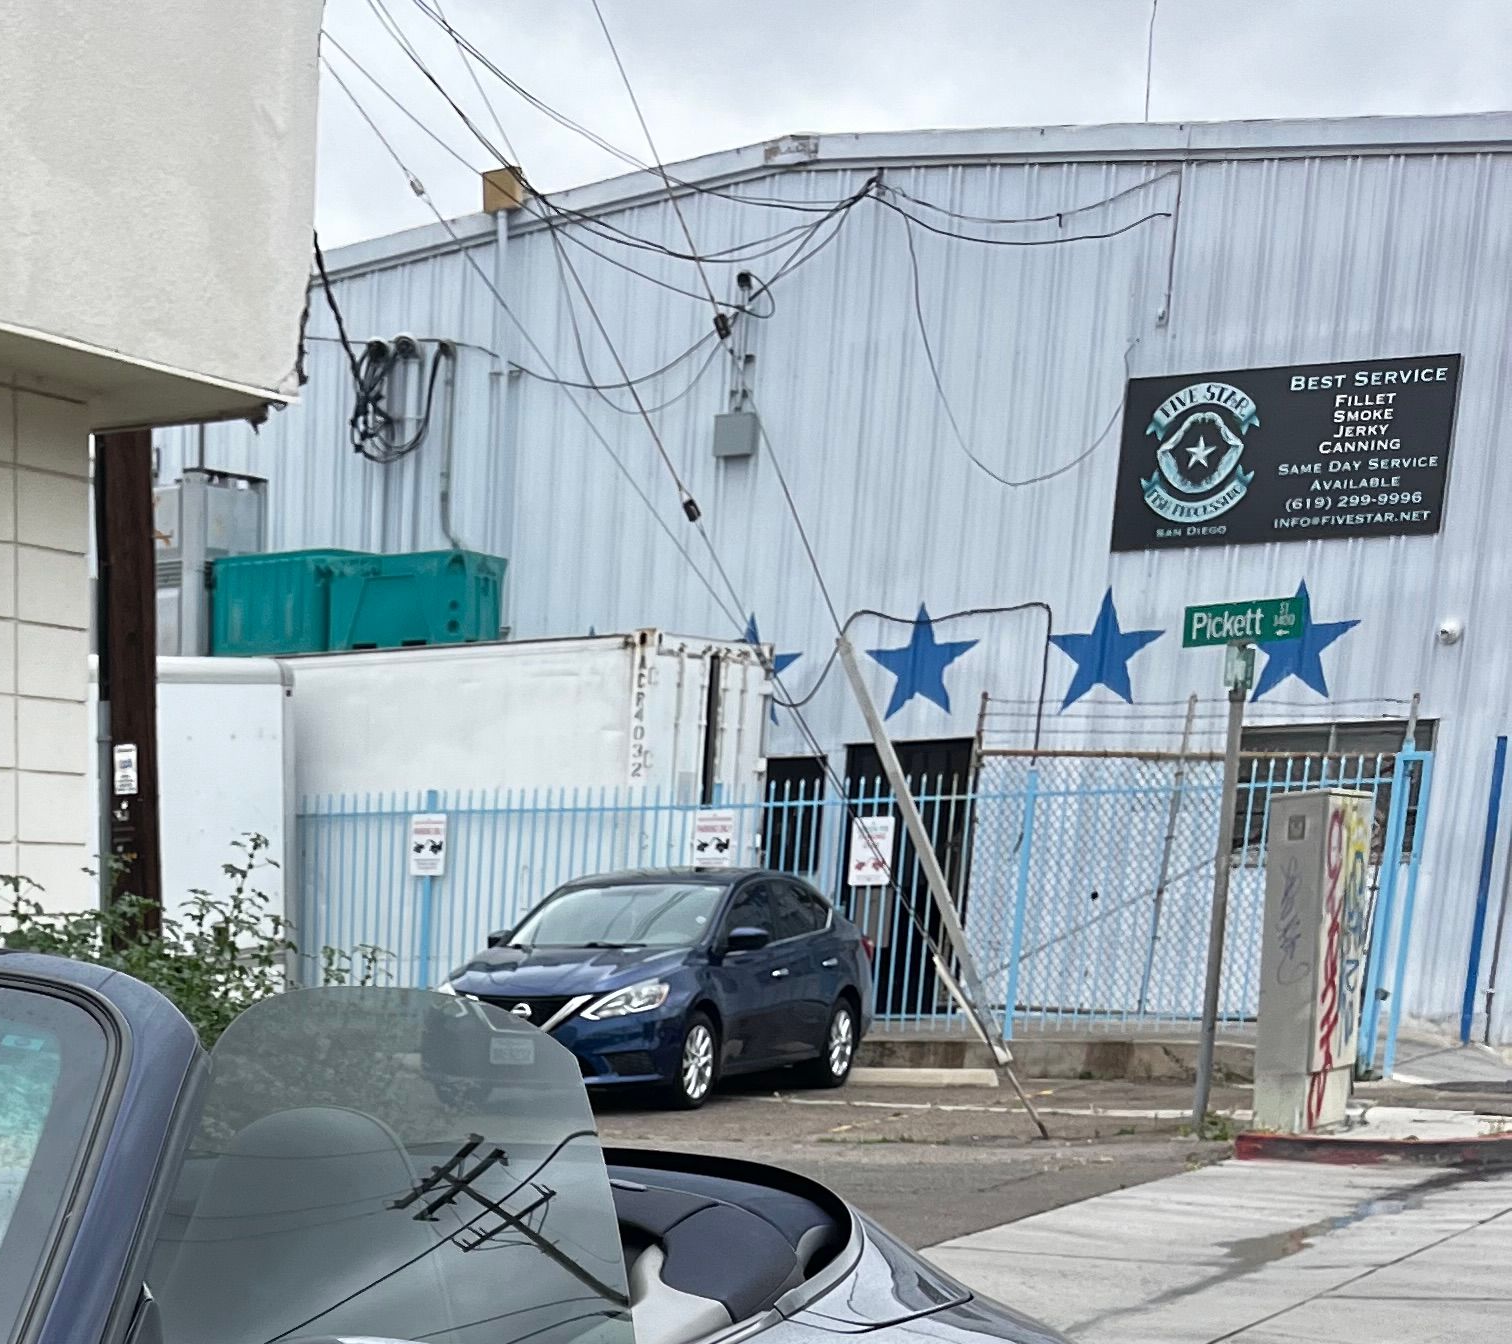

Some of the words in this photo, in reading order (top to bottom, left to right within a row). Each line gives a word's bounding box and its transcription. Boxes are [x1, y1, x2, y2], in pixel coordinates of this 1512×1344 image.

[1290, 374, 1346, 391] BEST
[1354, 367, 1449, 387] SERVICE
[1159, 388, 1198, 418] FIVE
[1206, 384, 1251, 418] STAR
[1335, 393, 1397, 408] FILLET
[1333, 408, 1394, 423] SMOKE
[1333, 424, 1390, 438] JERKY
[1318, 439, 1401, 454] CANNING
[1278, 463, 1322, 476] SAME
[1328, 460, 1362, 473] DAY
[1368, 456, 1439, 471] SERVICE
[1310, 476, 1400, 492] AVAILABLE
[1285, 496, 1332, 513] (619)
[1337, 491, 1422, 508] 299-9996
[1156, 528, 1182, 538] SAN
[1186, 526, 1227, 537] DIEGO
[1191, 607, 1265, 640] Pickett
